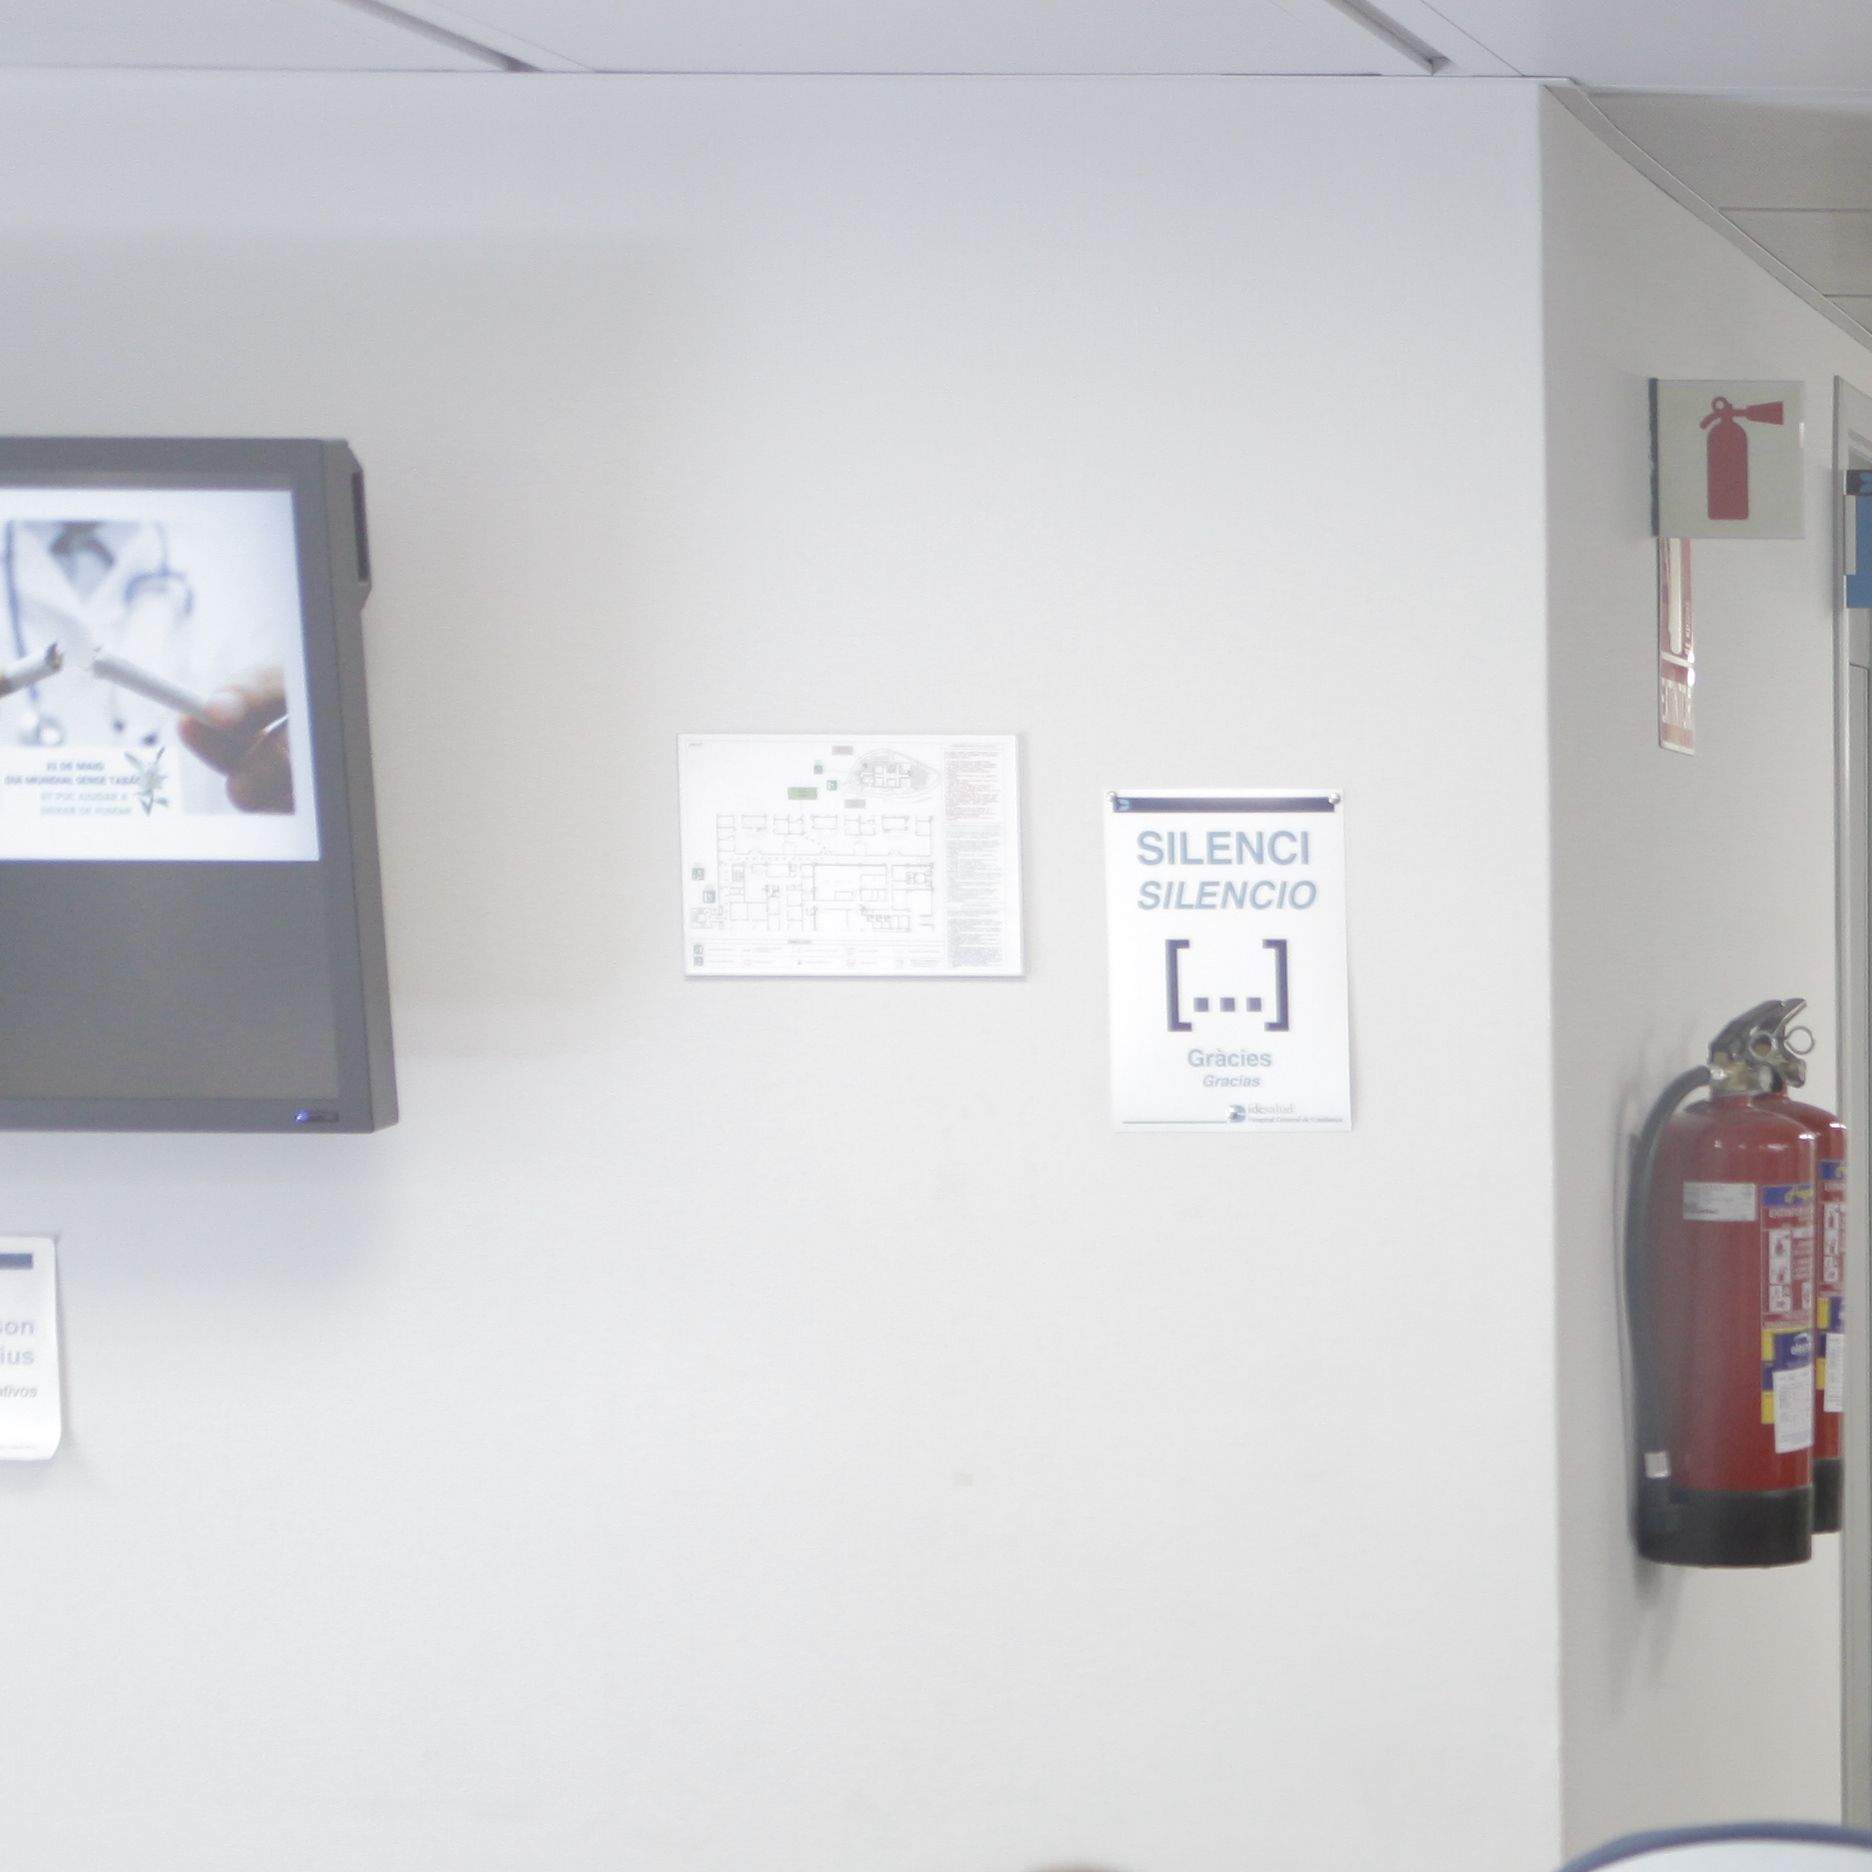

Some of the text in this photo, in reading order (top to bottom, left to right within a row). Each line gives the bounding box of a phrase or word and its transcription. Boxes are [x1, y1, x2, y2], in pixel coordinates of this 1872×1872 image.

[1136, 829, 1310, 866] SILENCI
[1136, 879, 1319, 911] SILENCIO
[1187, 1048, 1273, 1069] Gràcies
[1202, 1073, 1262, 1089] Gracias
[0, 1318, 34, 1336] on
